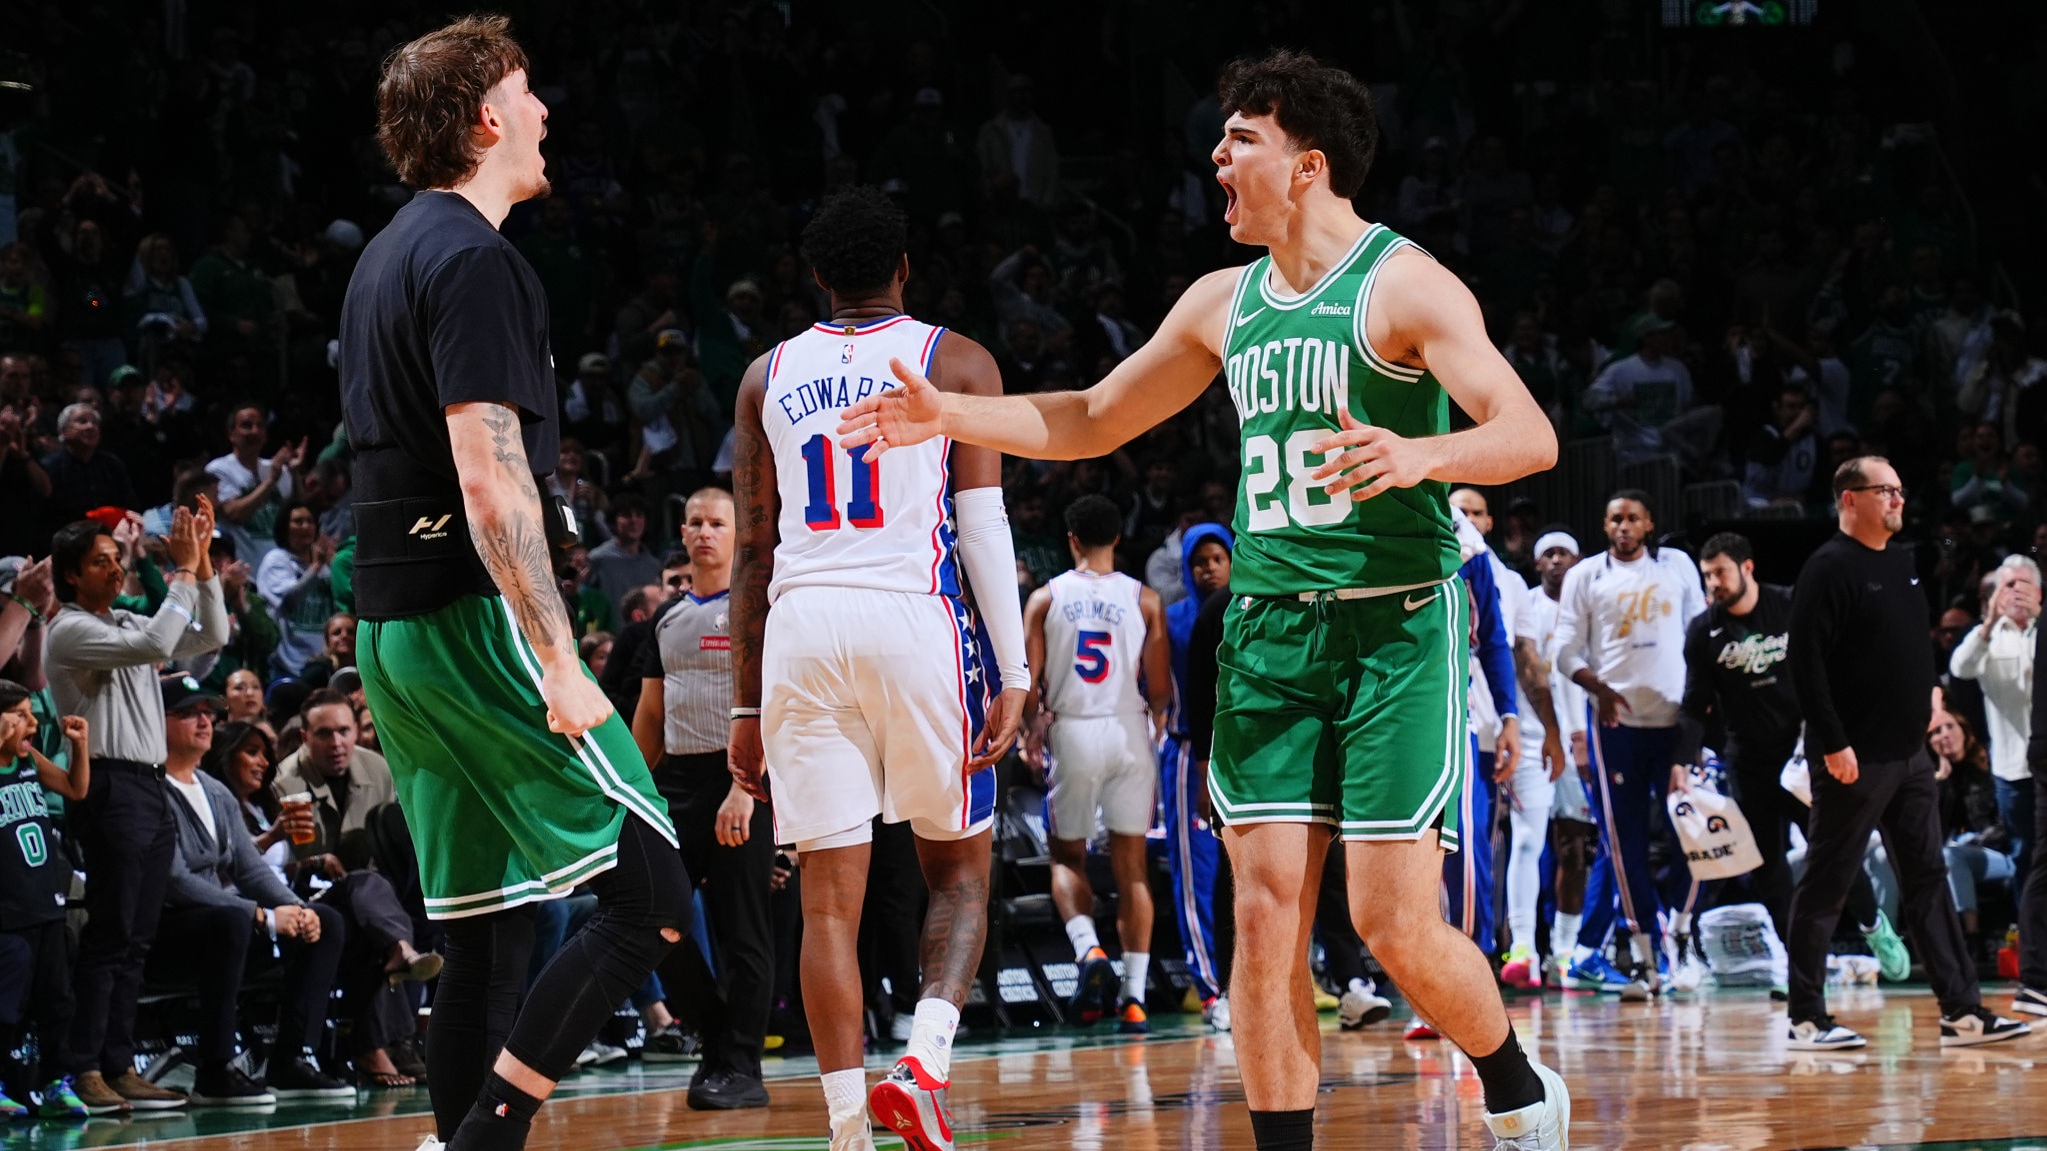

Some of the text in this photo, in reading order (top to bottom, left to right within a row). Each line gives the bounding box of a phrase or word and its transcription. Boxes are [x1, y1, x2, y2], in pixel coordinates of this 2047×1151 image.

[1311, 301, 1351, 316] Amica
[1227, 337, 1350, 430] BOSTON
[801, 433, 884, 532] 11
[1245, 428, 1353, 532] 28
[420, 531, 448, 541] Hyperice
[1063, 600, 1127, 626] GRIMES
[1074, 630, 1112, 684] 5
[15, 821, 48, 868] 0
